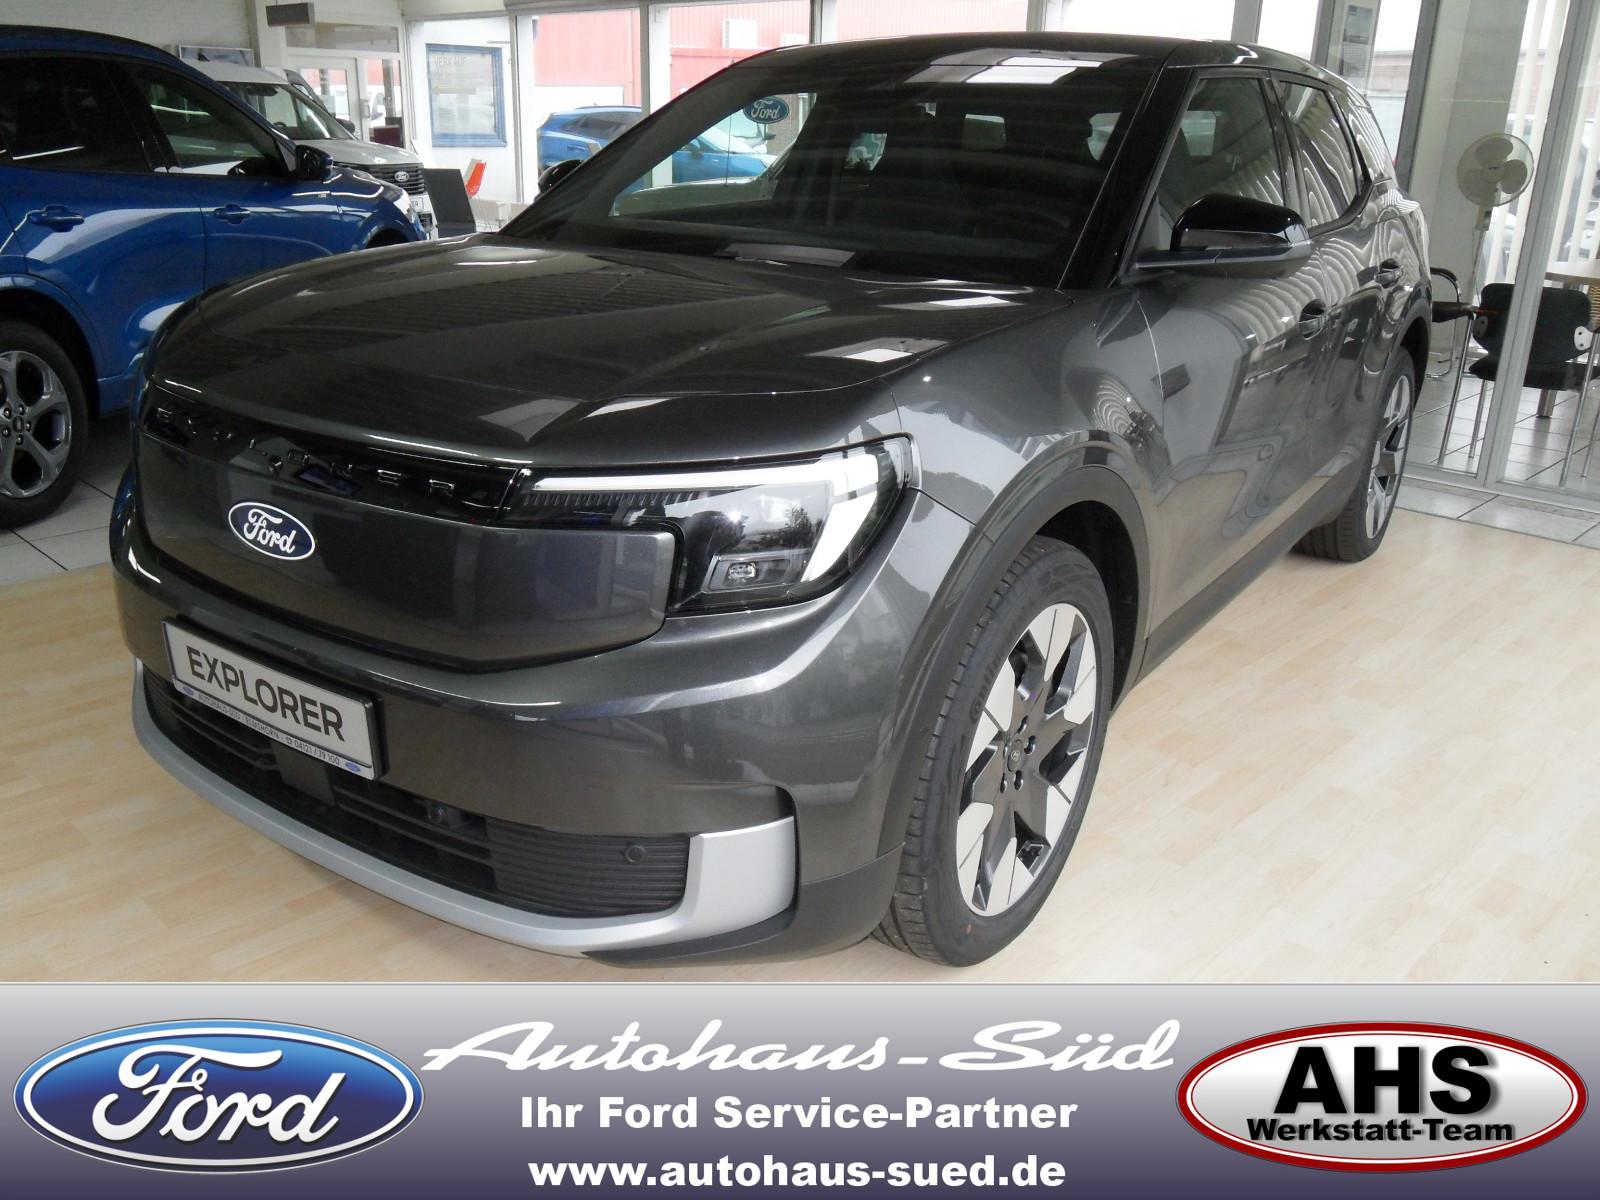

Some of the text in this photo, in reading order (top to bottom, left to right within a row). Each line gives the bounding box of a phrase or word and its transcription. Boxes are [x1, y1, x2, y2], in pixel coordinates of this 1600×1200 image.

[751, 99, 780, 119] Ford
[154, 407, 455, 497] ELOER
[243, 508, 297, 553] Ford
[186, 645, 345, 741] EXPLORER
